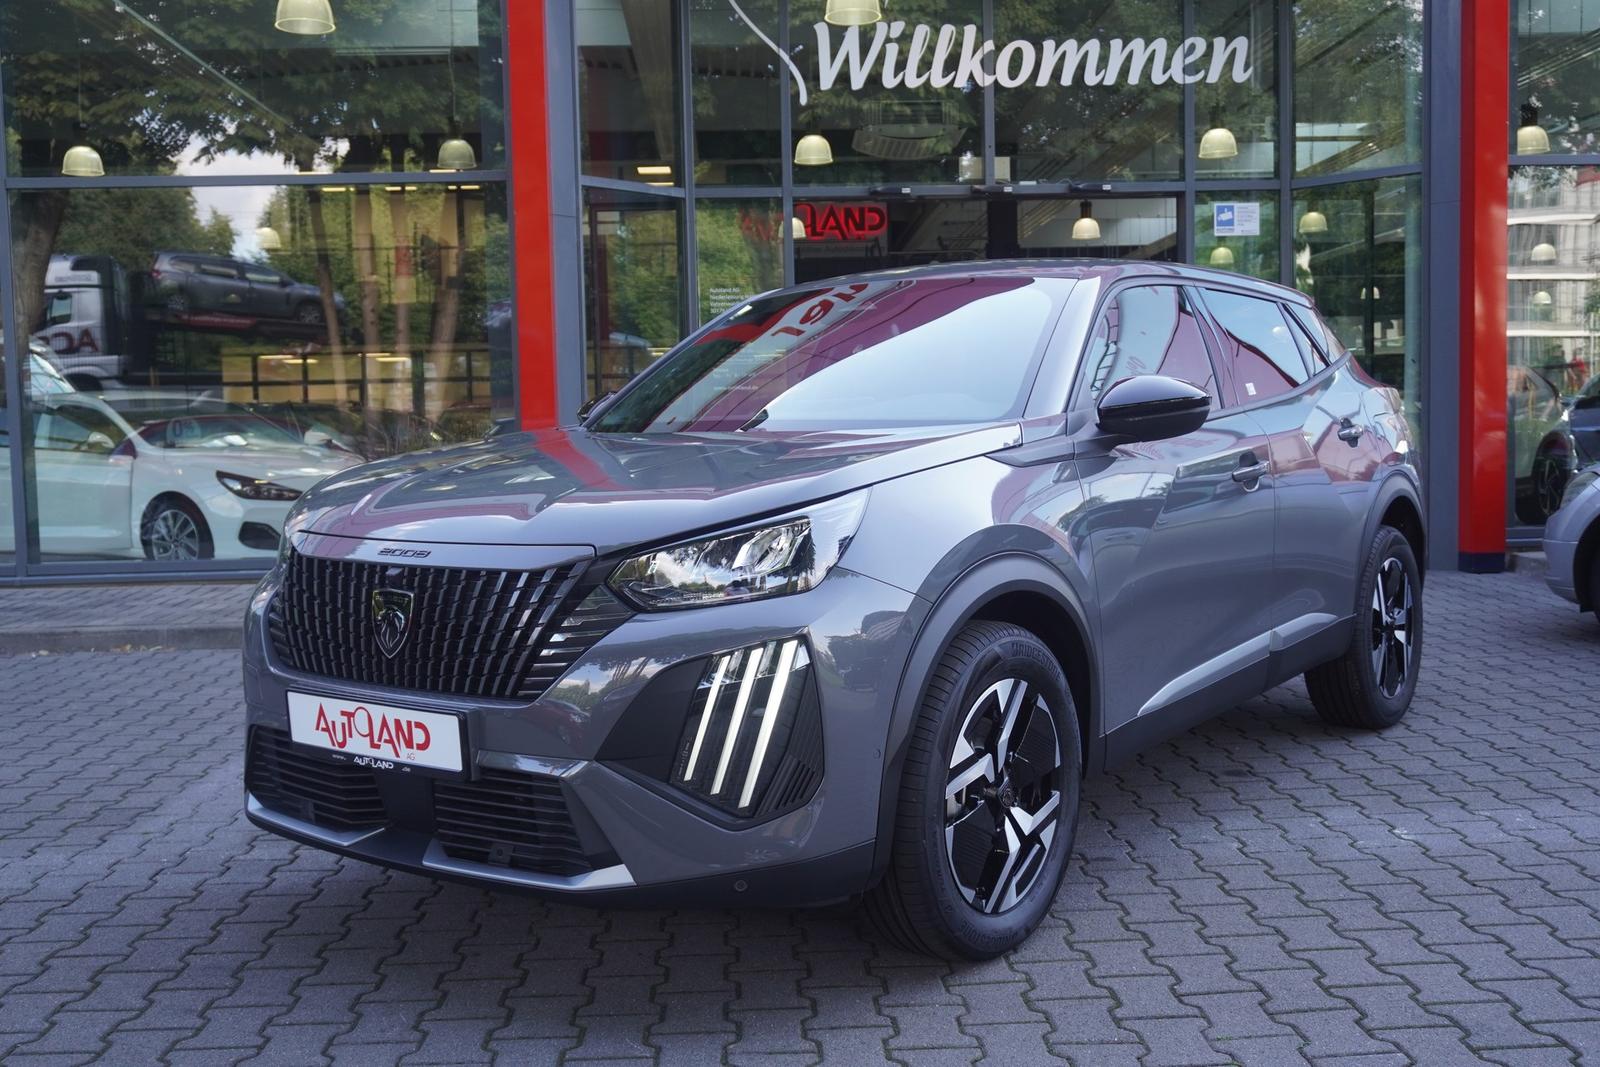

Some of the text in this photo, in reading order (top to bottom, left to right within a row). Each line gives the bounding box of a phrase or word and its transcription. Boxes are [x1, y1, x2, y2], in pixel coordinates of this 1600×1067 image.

[813, 20, 1253, 91] Willkommen
[377, 547, 432, 559] 2008
[315, 702, 431, 758] AUTOLAND
[353, 756, 394, 770] AUTOLAND
